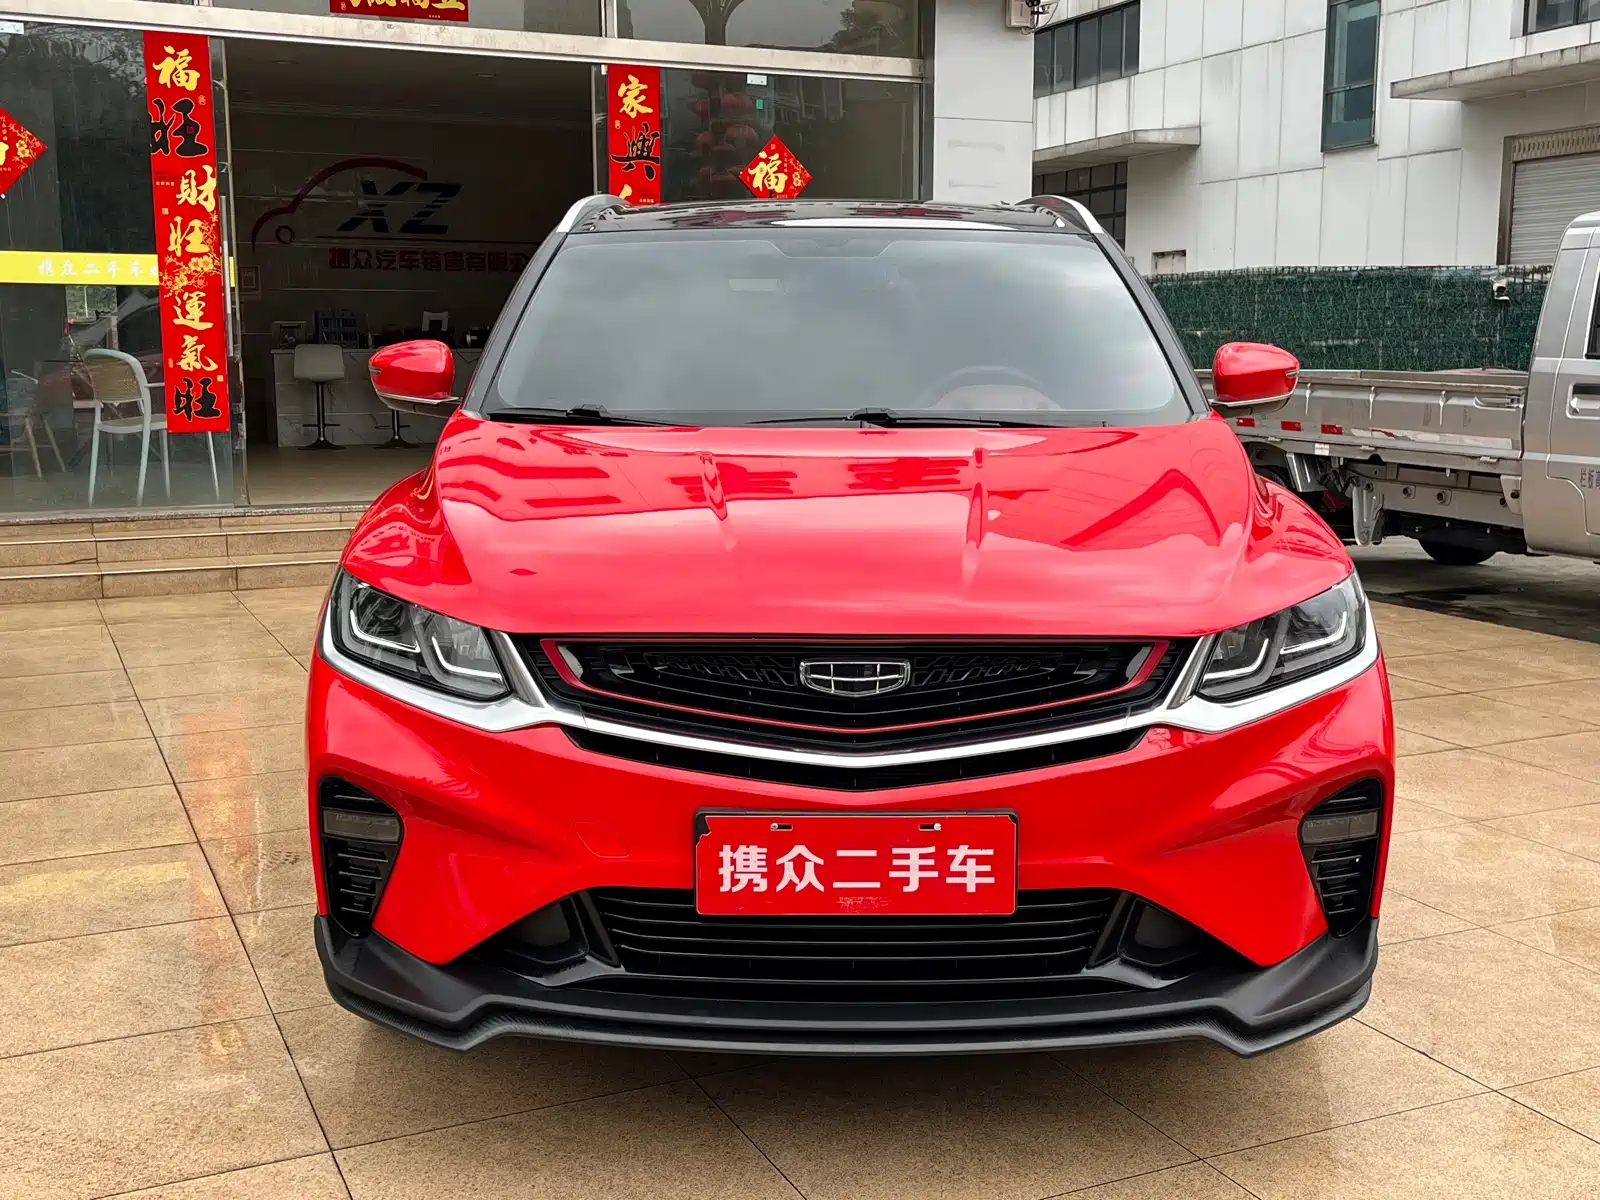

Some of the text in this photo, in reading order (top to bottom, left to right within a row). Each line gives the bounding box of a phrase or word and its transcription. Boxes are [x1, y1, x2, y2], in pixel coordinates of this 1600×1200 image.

[609, 74, 661, 201] 家興
[748, 151, 788, 193] 福
[336, 180, 463, 234] XZ
[718, 844, 995, 893] 携众二手车
